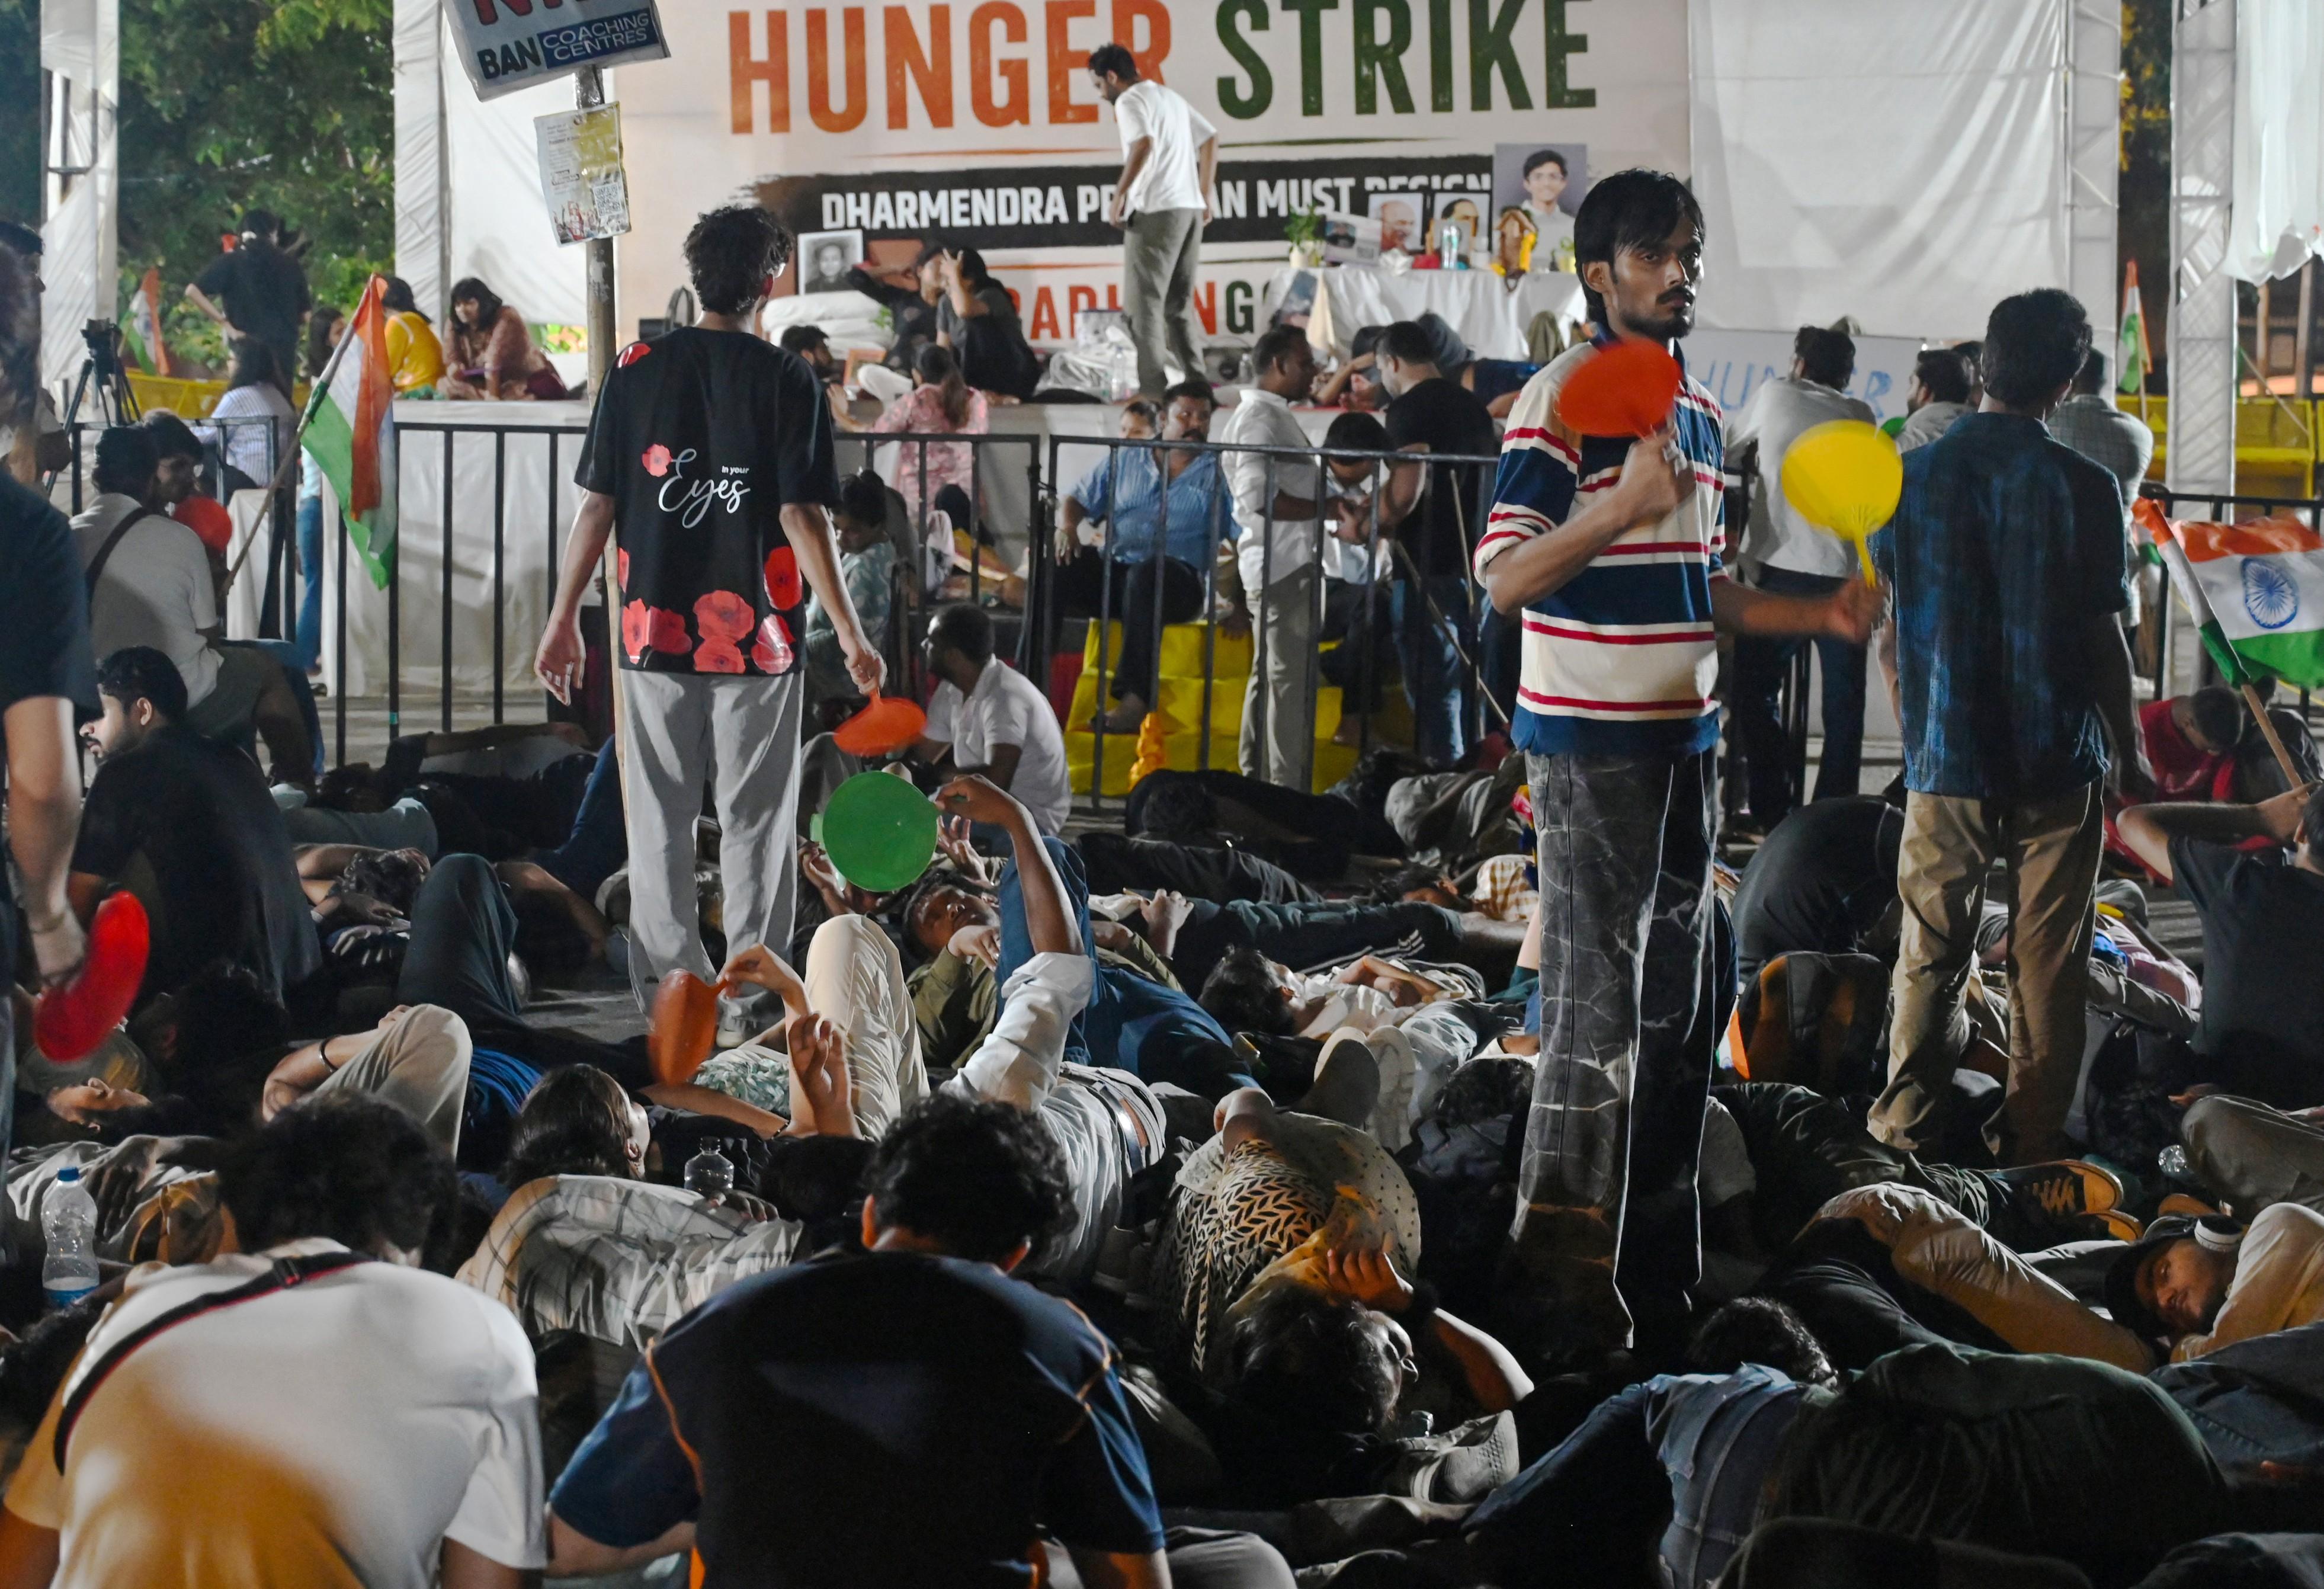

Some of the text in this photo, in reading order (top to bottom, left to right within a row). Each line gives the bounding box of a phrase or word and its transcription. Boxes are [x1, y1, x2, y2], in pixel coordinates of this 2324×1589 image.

[542, 12, 650, 49] COACHING
[553, 28, 647, 60] CENTRES
[477, 37, 541, 79] BAN
[728, 0, 1597, 135] HUNGER STRIKE
[822, 185, 1069, 230] DHARMENDRA
[1256, 178, 1356, 218] MUST
[658, 448, 751, 529] Eyes
[729, 466, 749, 476] your
